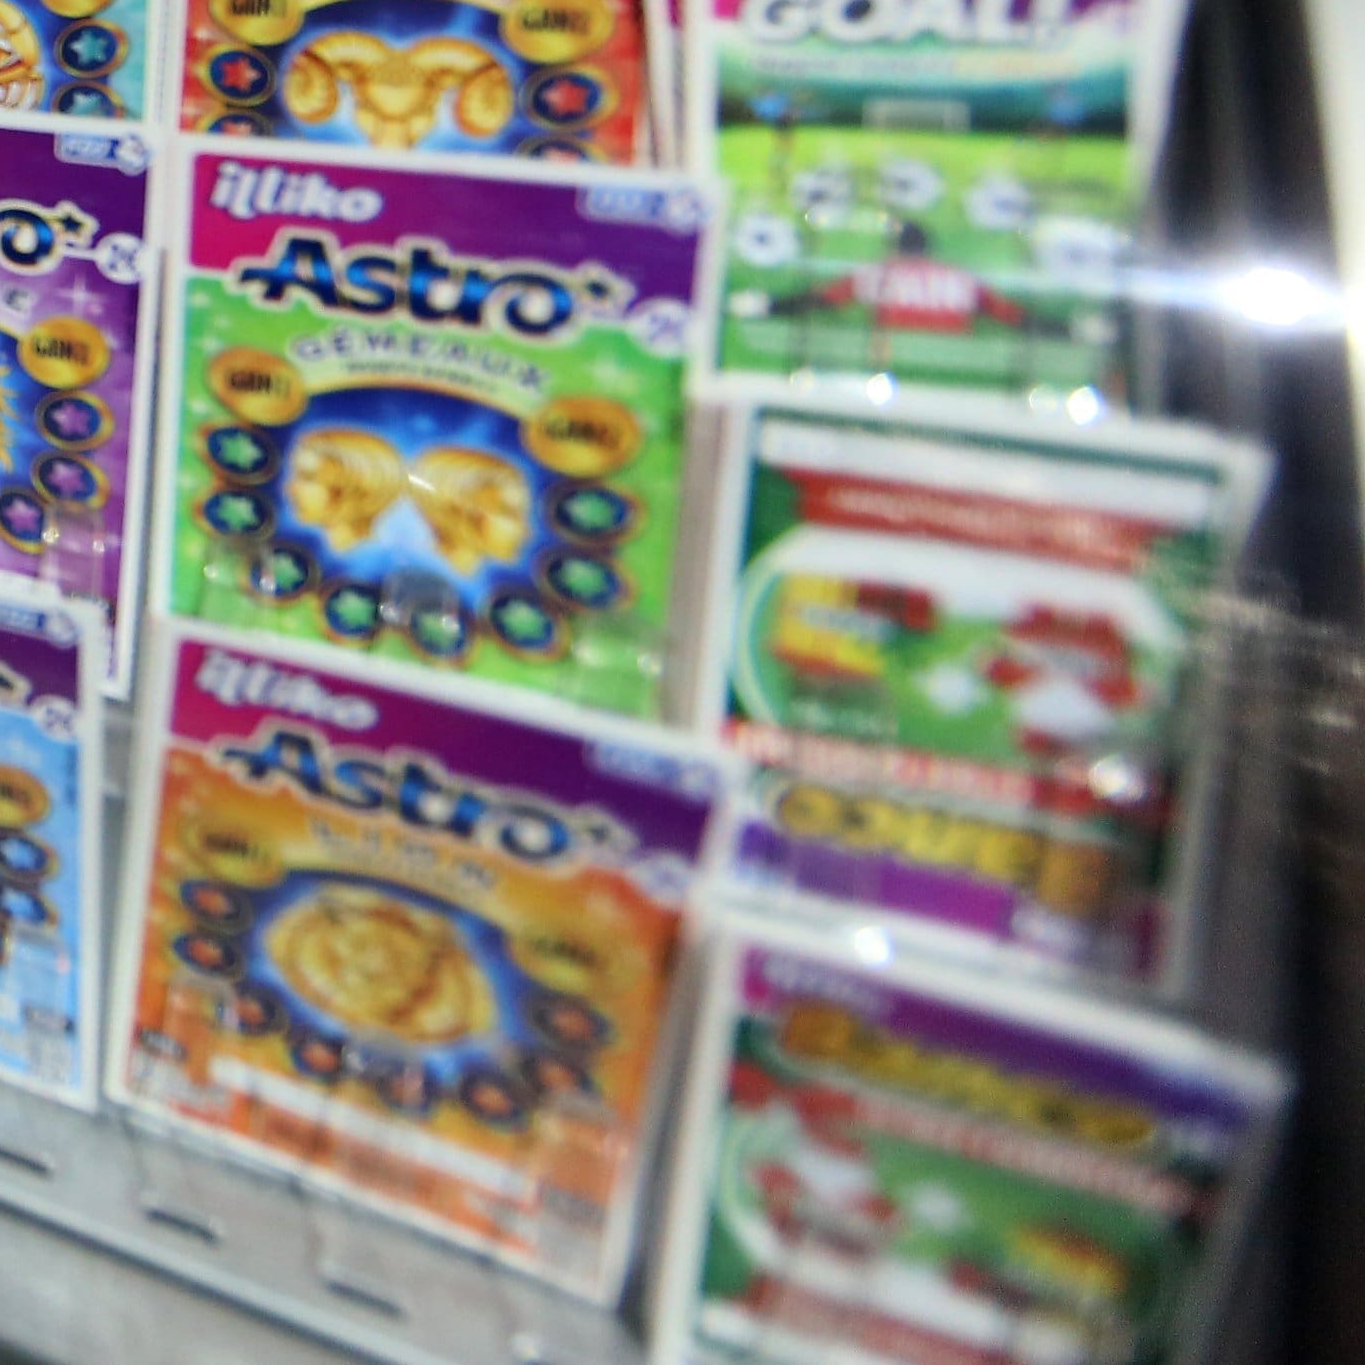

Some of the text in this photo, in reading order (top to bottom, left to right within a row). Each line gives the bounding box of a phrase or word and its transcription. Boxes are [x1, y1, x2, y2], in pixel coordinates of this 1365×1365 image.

[210, 160, 384, 223] illiko
[241, 237, 574, 337] Astro
[222, 730, 572, 862] Astro
